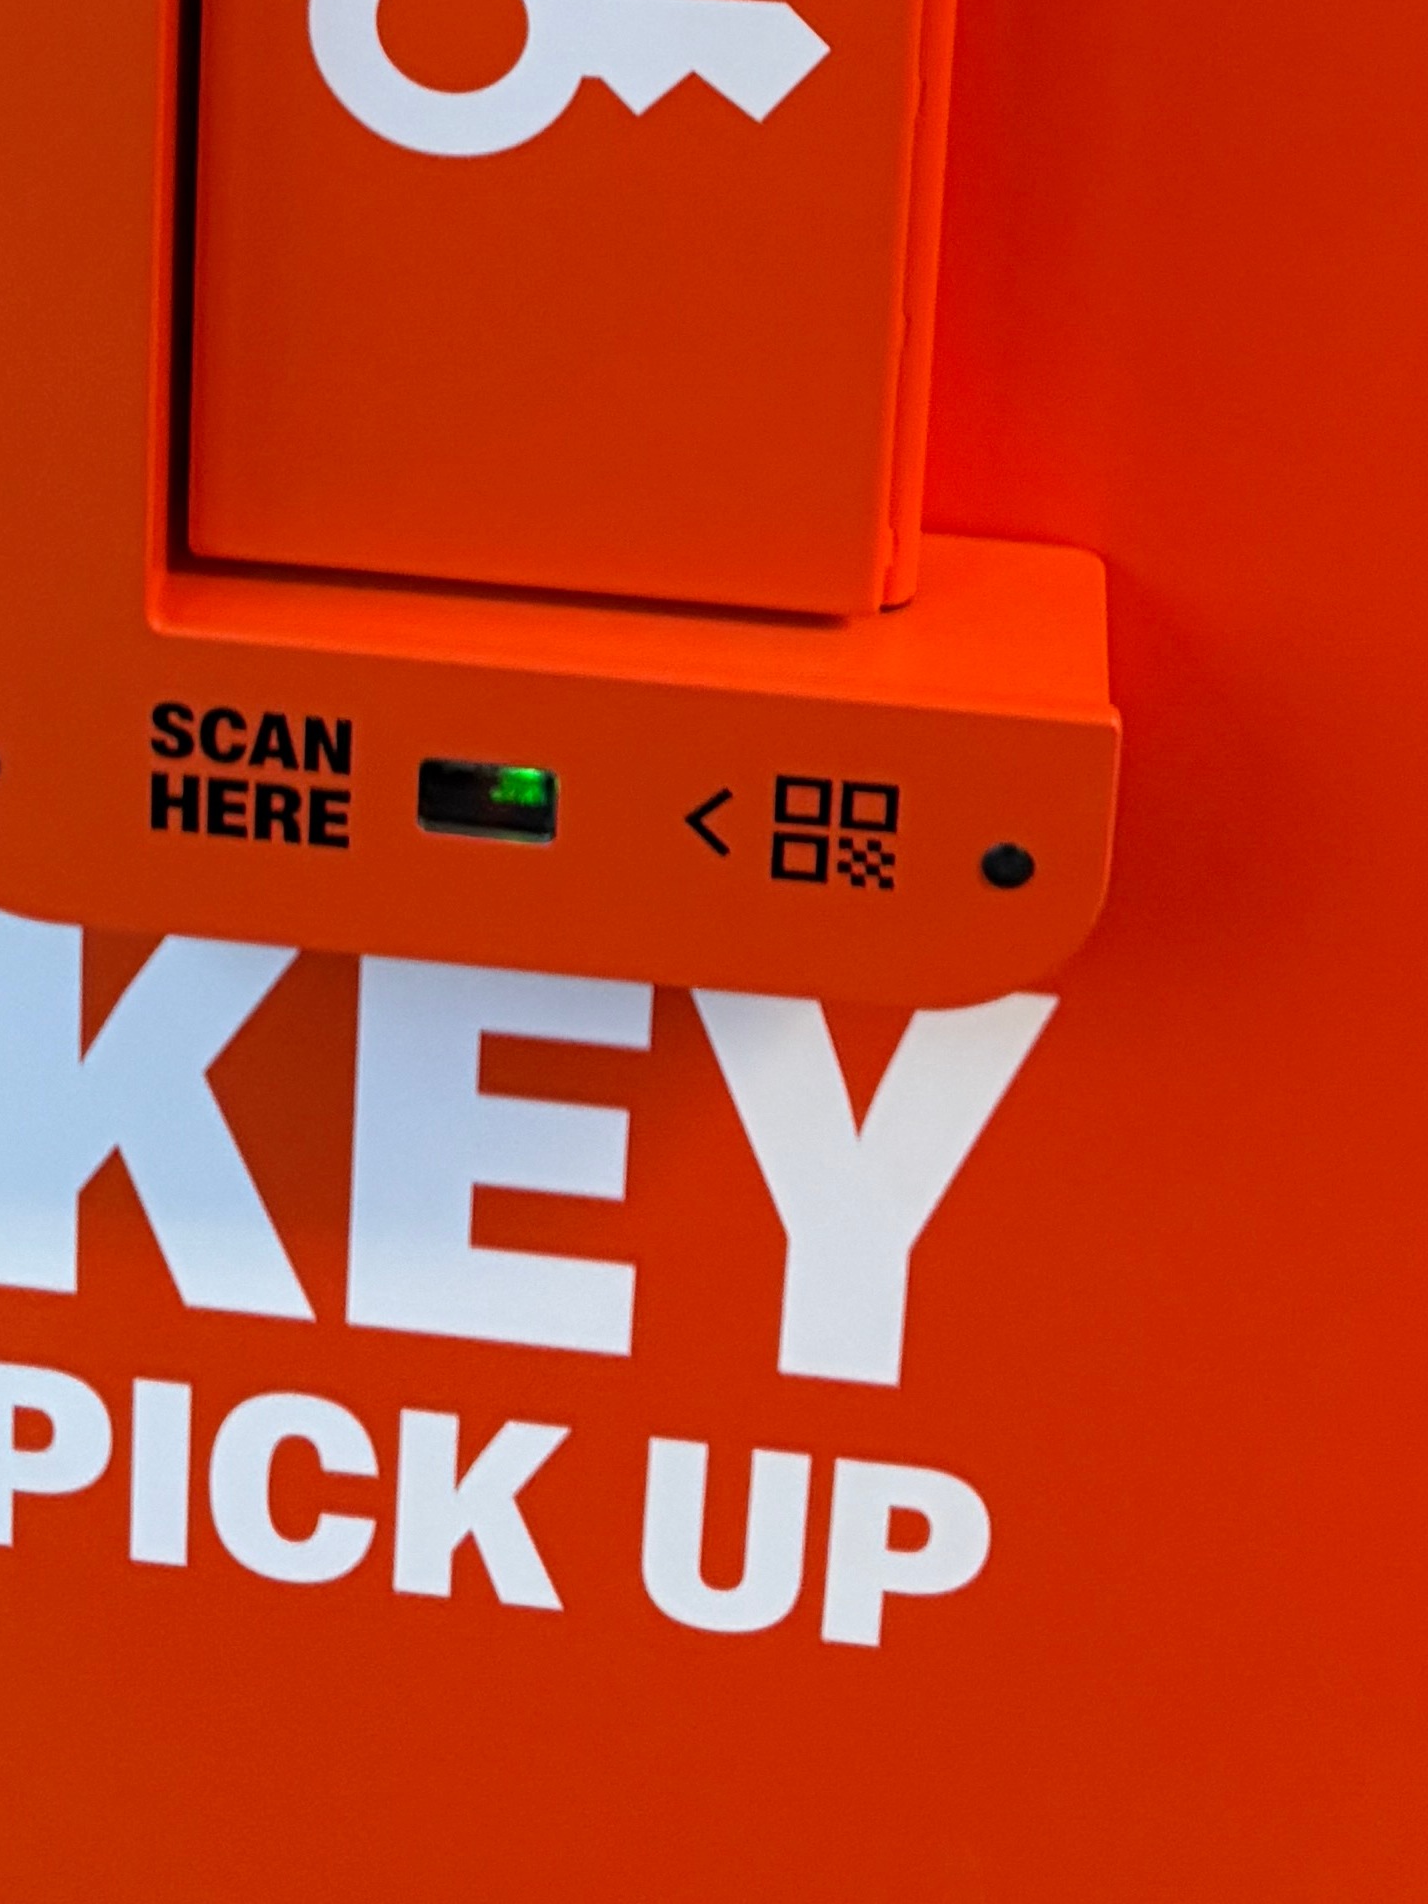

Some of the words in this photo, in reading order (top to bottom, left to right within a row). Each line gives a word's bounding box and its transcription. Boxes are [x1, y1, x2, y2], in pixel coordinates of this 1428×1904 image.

[149, 701, 353, 776] SCAN
[149, 770, 352, 850] HERE
[641, 1436, 992, 1648] UP
